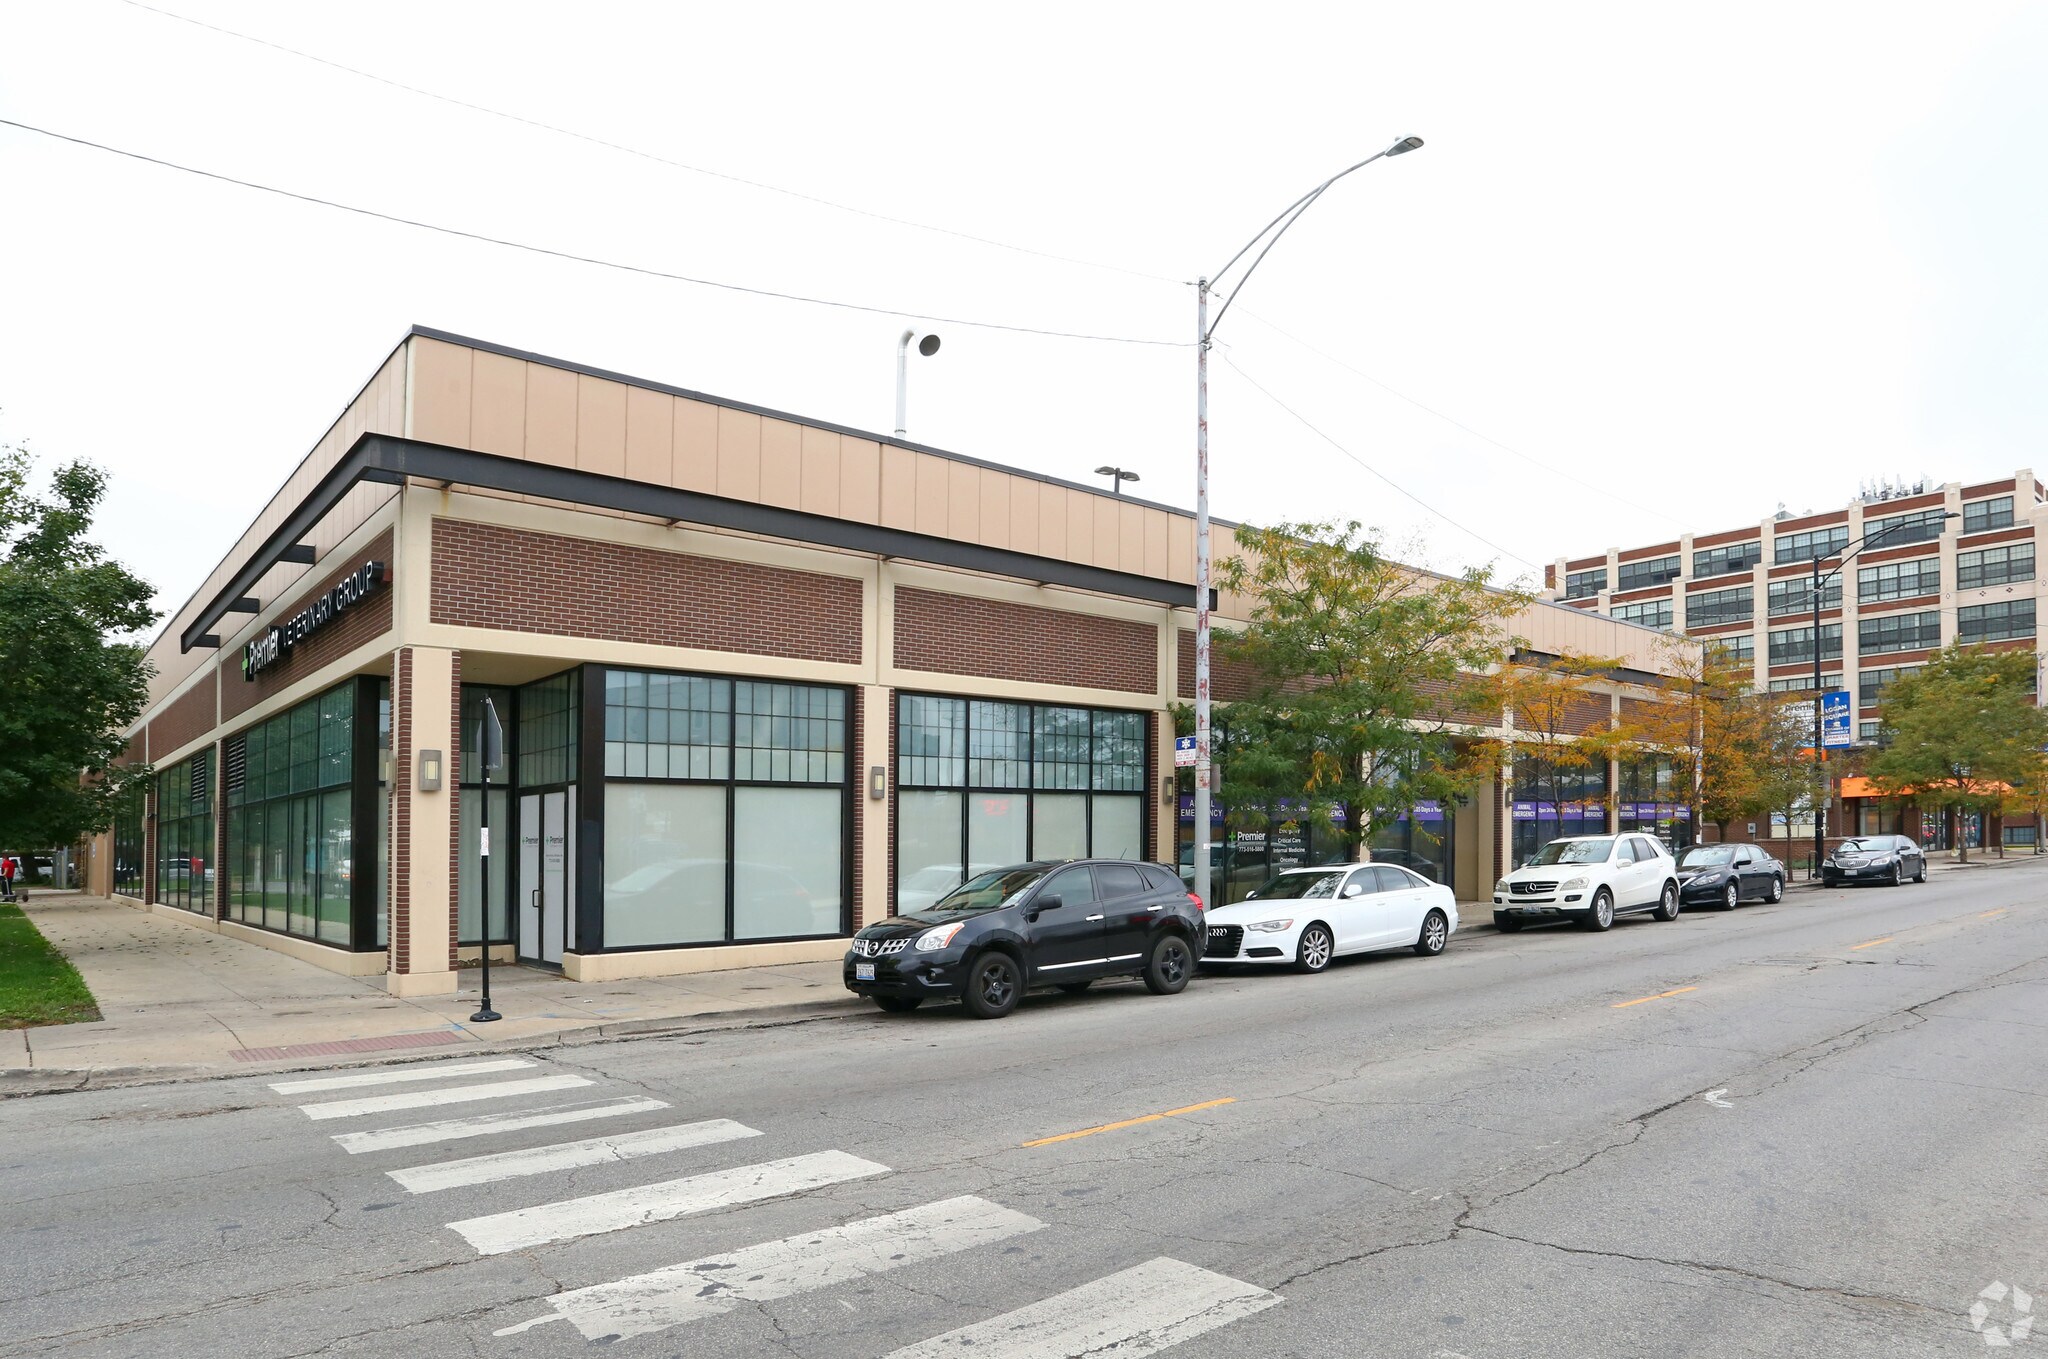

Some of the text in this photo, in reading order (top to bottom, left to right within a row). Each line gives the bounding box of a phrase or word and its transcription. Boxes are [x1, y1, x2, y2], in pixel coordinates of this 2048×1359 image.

[249, 626, 279, 675] Premier
[335, 560, 373, 611] GROUP
[1785, 704, 1815, 712] Premie
[1825, 704, 1847, 714] LOGAN
[1824, 711, 1850, 720] SQUARE
[1237, 830, 1266, 841] Premier
